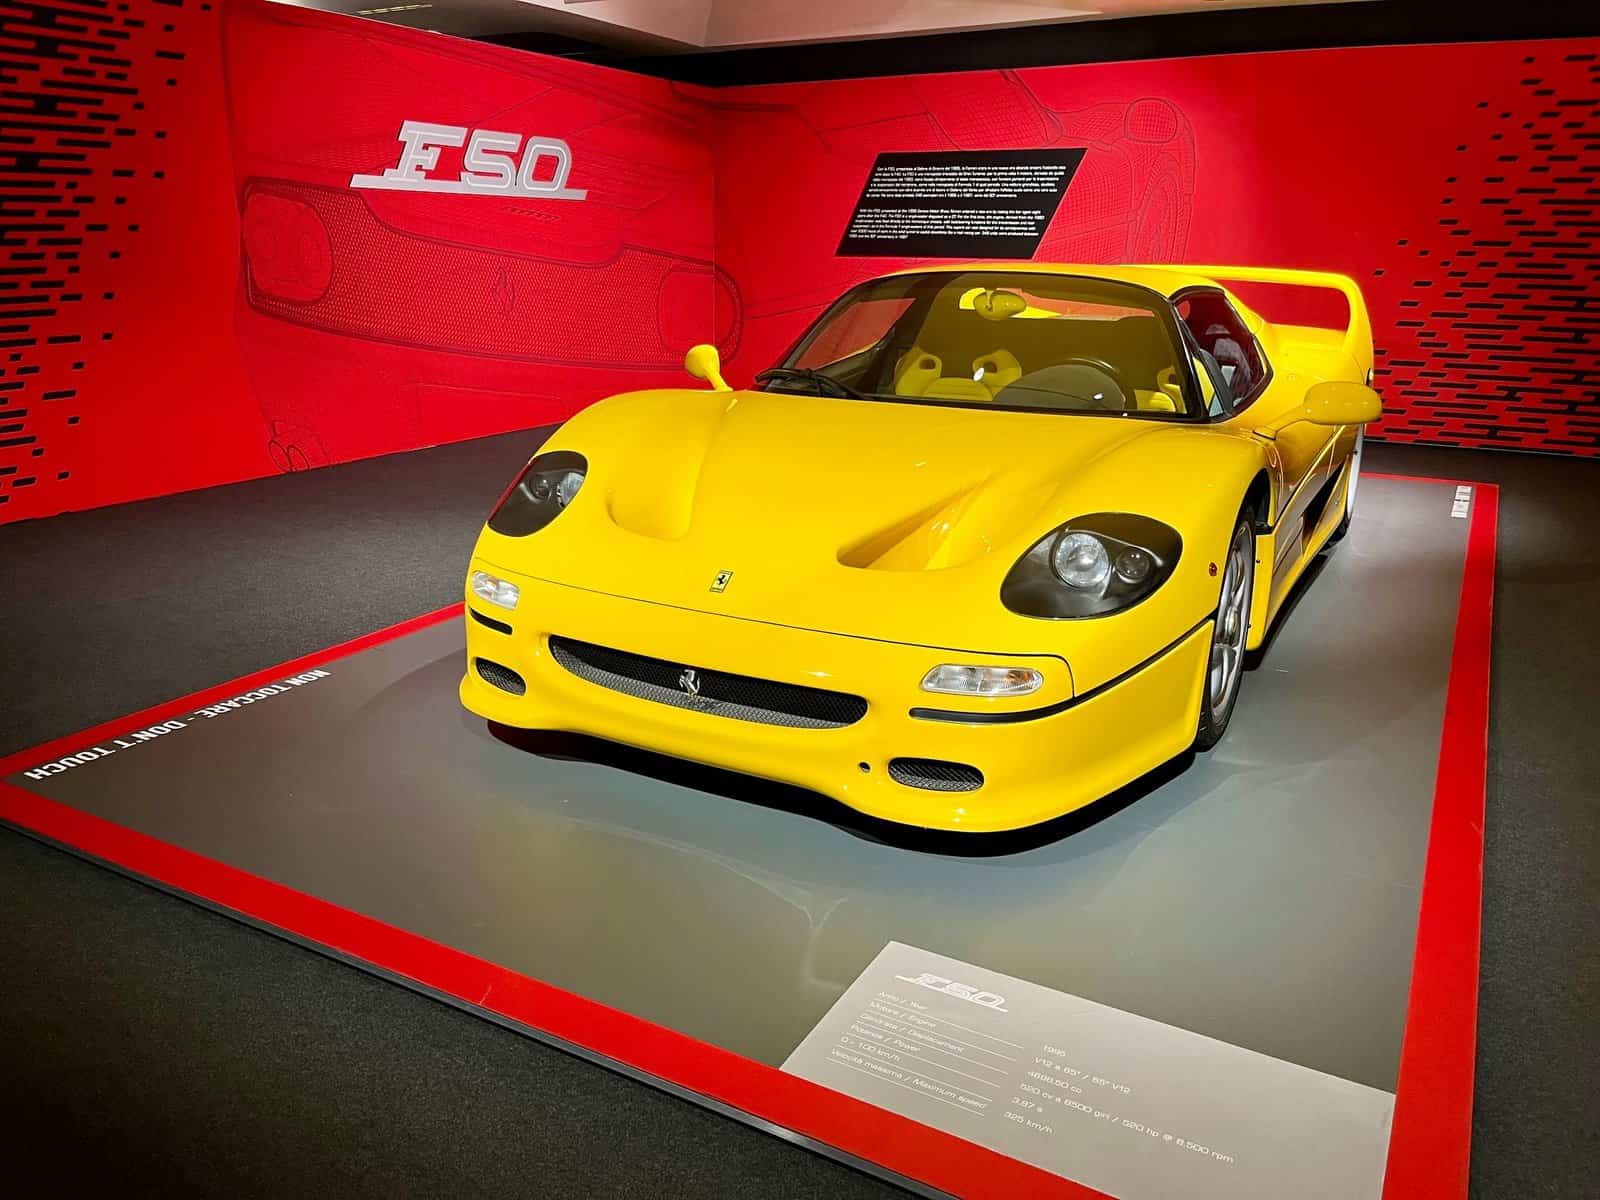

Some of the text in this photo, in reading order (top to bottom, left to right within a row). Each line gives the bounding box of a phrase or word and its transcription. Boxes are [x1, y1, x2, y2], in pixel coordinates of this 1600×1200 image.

[384, 120, 575, 194] F50
[286, 669, 332, 687] NON
[194, 684, 292, 717] TOCCARE
[113, 720, 188, 749] DON'T
[24, 747, 116, 780] TOUCH
